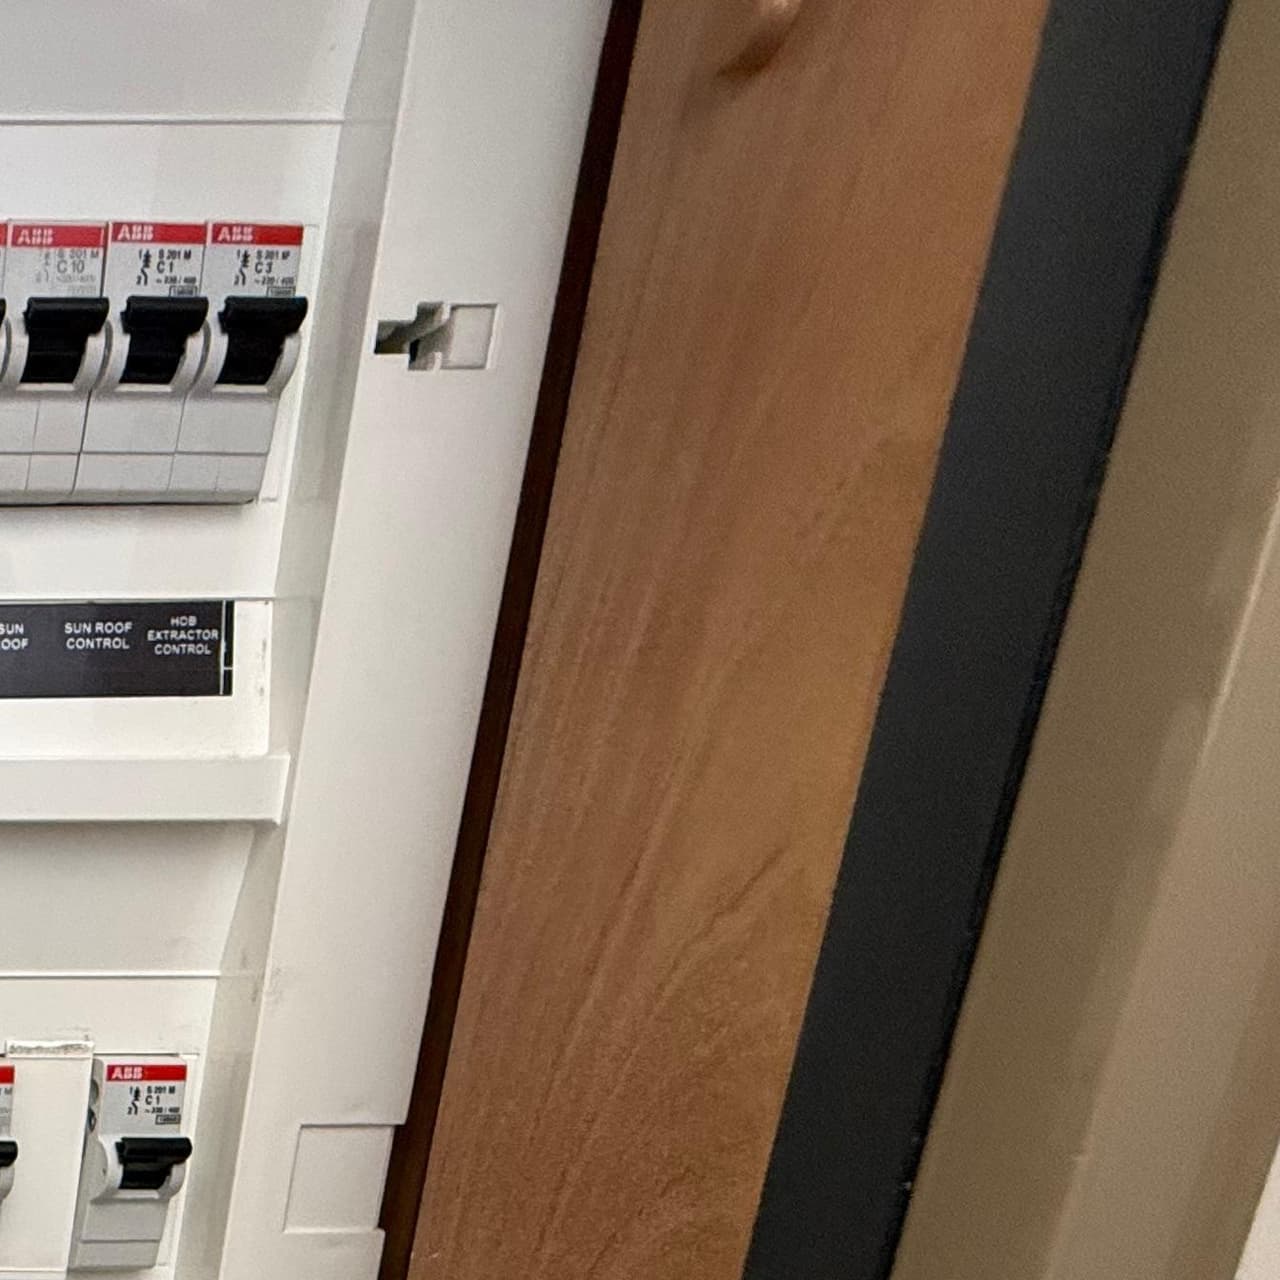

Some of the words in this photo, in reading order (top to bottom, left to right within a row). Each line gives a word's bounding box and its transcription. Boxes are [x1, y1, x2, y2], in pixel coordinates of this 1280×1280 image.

[65, 622, 92, 634] SUN
[95, 622, 132, 634] ROOF
[147, 629, 218, 641] EXTRACTOR
[66, 637, 130, 650] CONTROL
[154, 643, 211, 655] CONTROL
